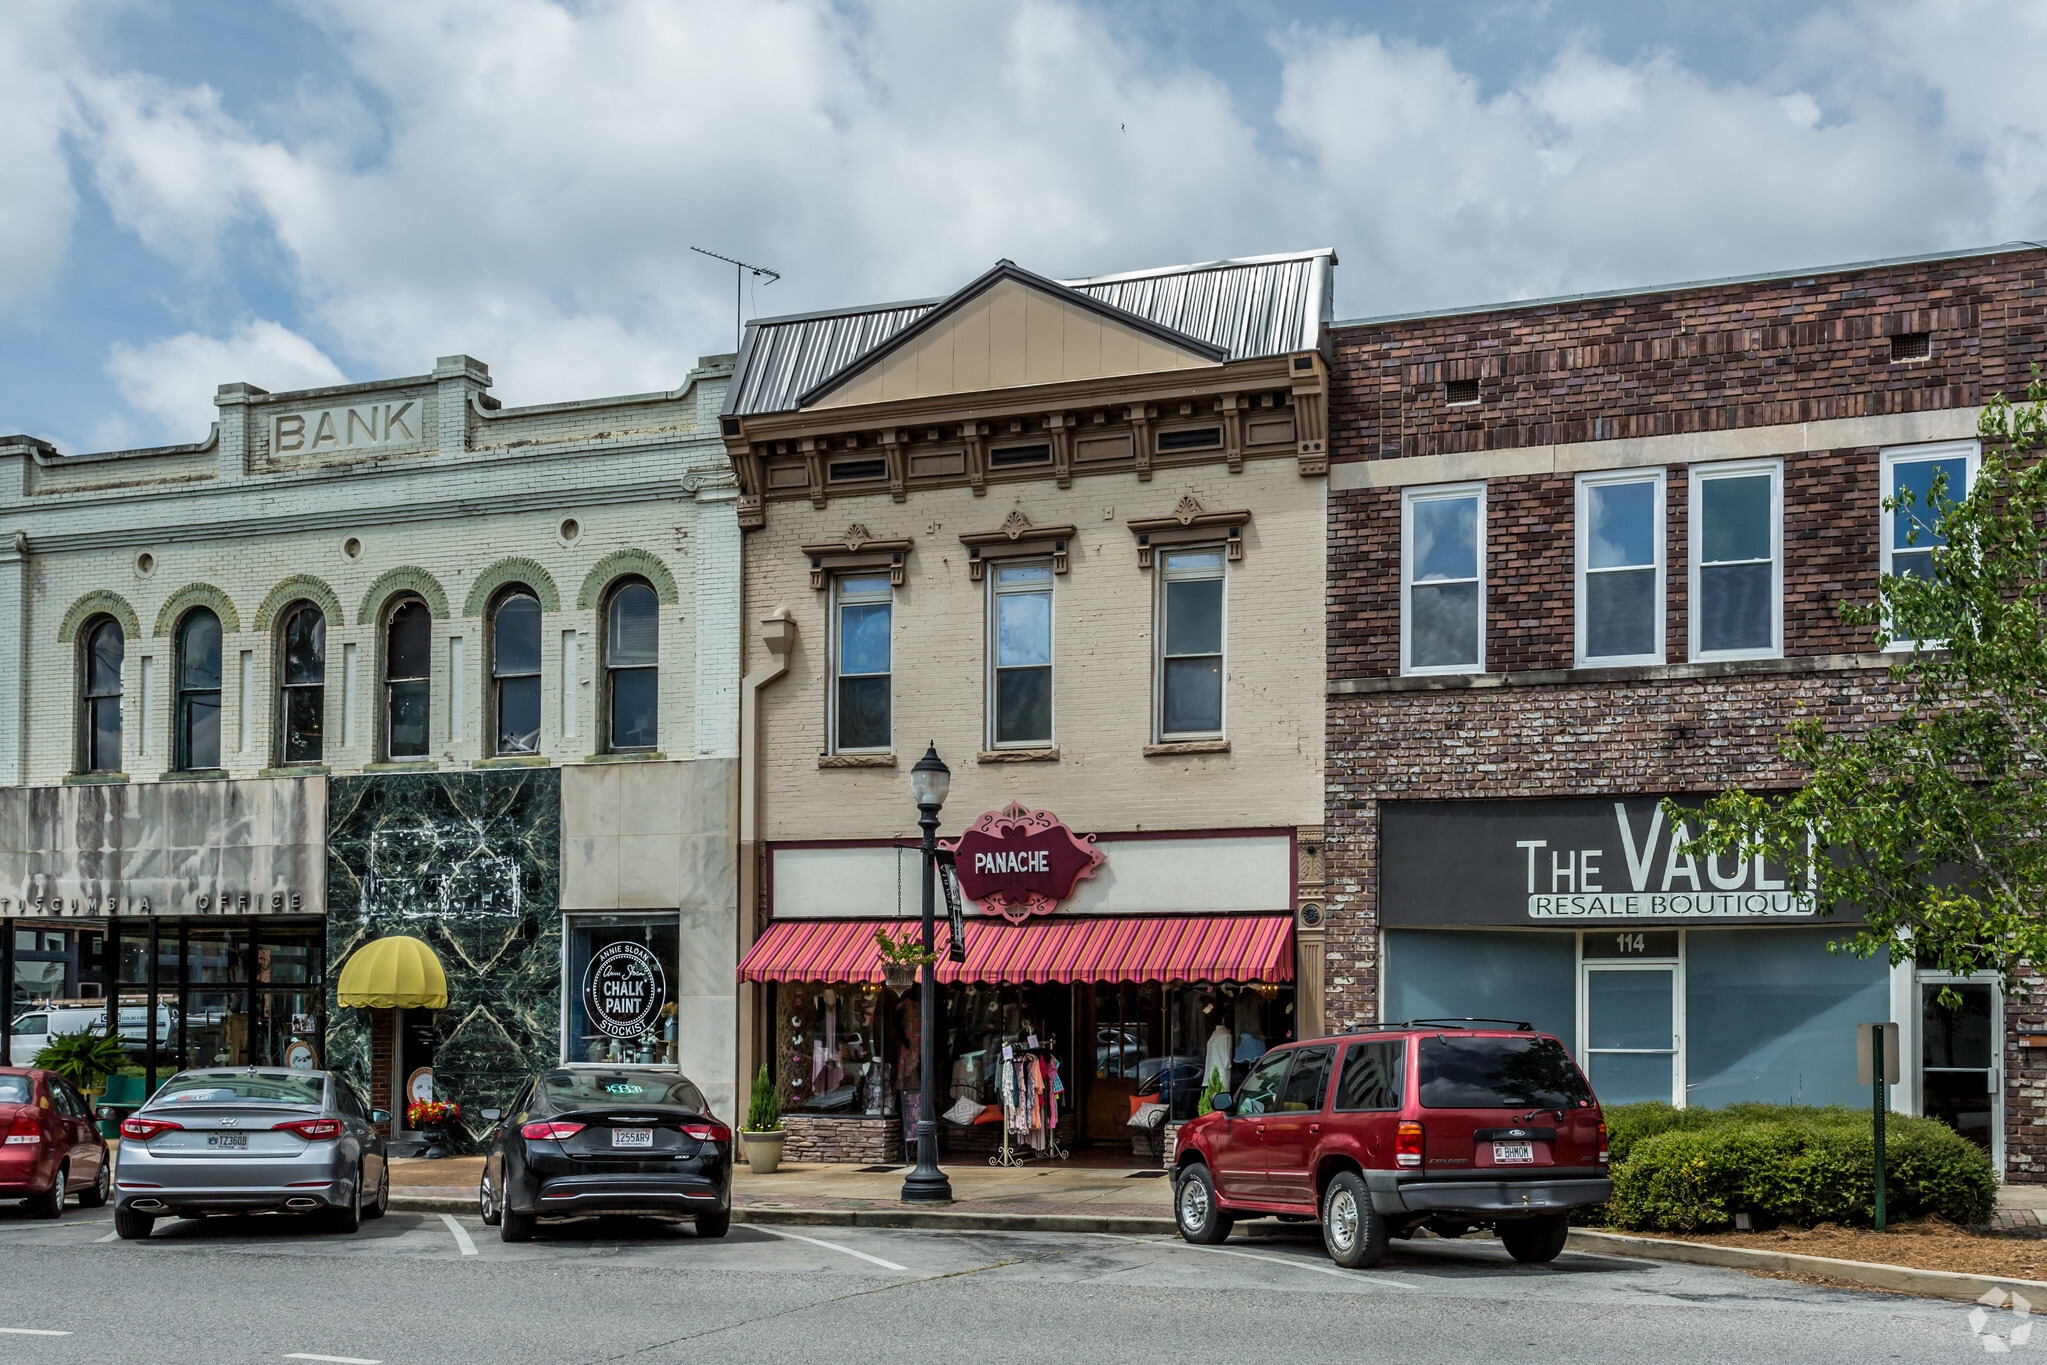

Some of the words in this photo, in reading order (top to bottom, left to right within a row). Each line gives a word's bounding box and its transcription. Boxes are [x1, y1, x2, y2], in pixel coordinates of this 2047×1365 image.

[275, 402, 416, 454] BANK
[975, 851, 1050, 874] PANACHE
[1516, 840, 1603, 894] THE
[0, 898, 150, 912] TUSCUMBIA
[199, 894, 301, 909] OFFICE
[1536, 896, 1639, 915] RESALE
[1652, 895, 1812, 915] BOUTIQUE
[1616, 933, 1645, 953] 114
[600, 945, 622, 961] ANNIE
[624, 945, 649, 961] SLOAN
[603, 981, 645, 996] CHALK
[606, 998, 642, 1013] PAINT
[600, 1019, 647, 1036] STOCKIST
[219, 1135, 248, 1146] TZ360B
[616, 1132, 650, 1143] 1255AR9
[1504, 1146, 1529, 1158] BHMOM
